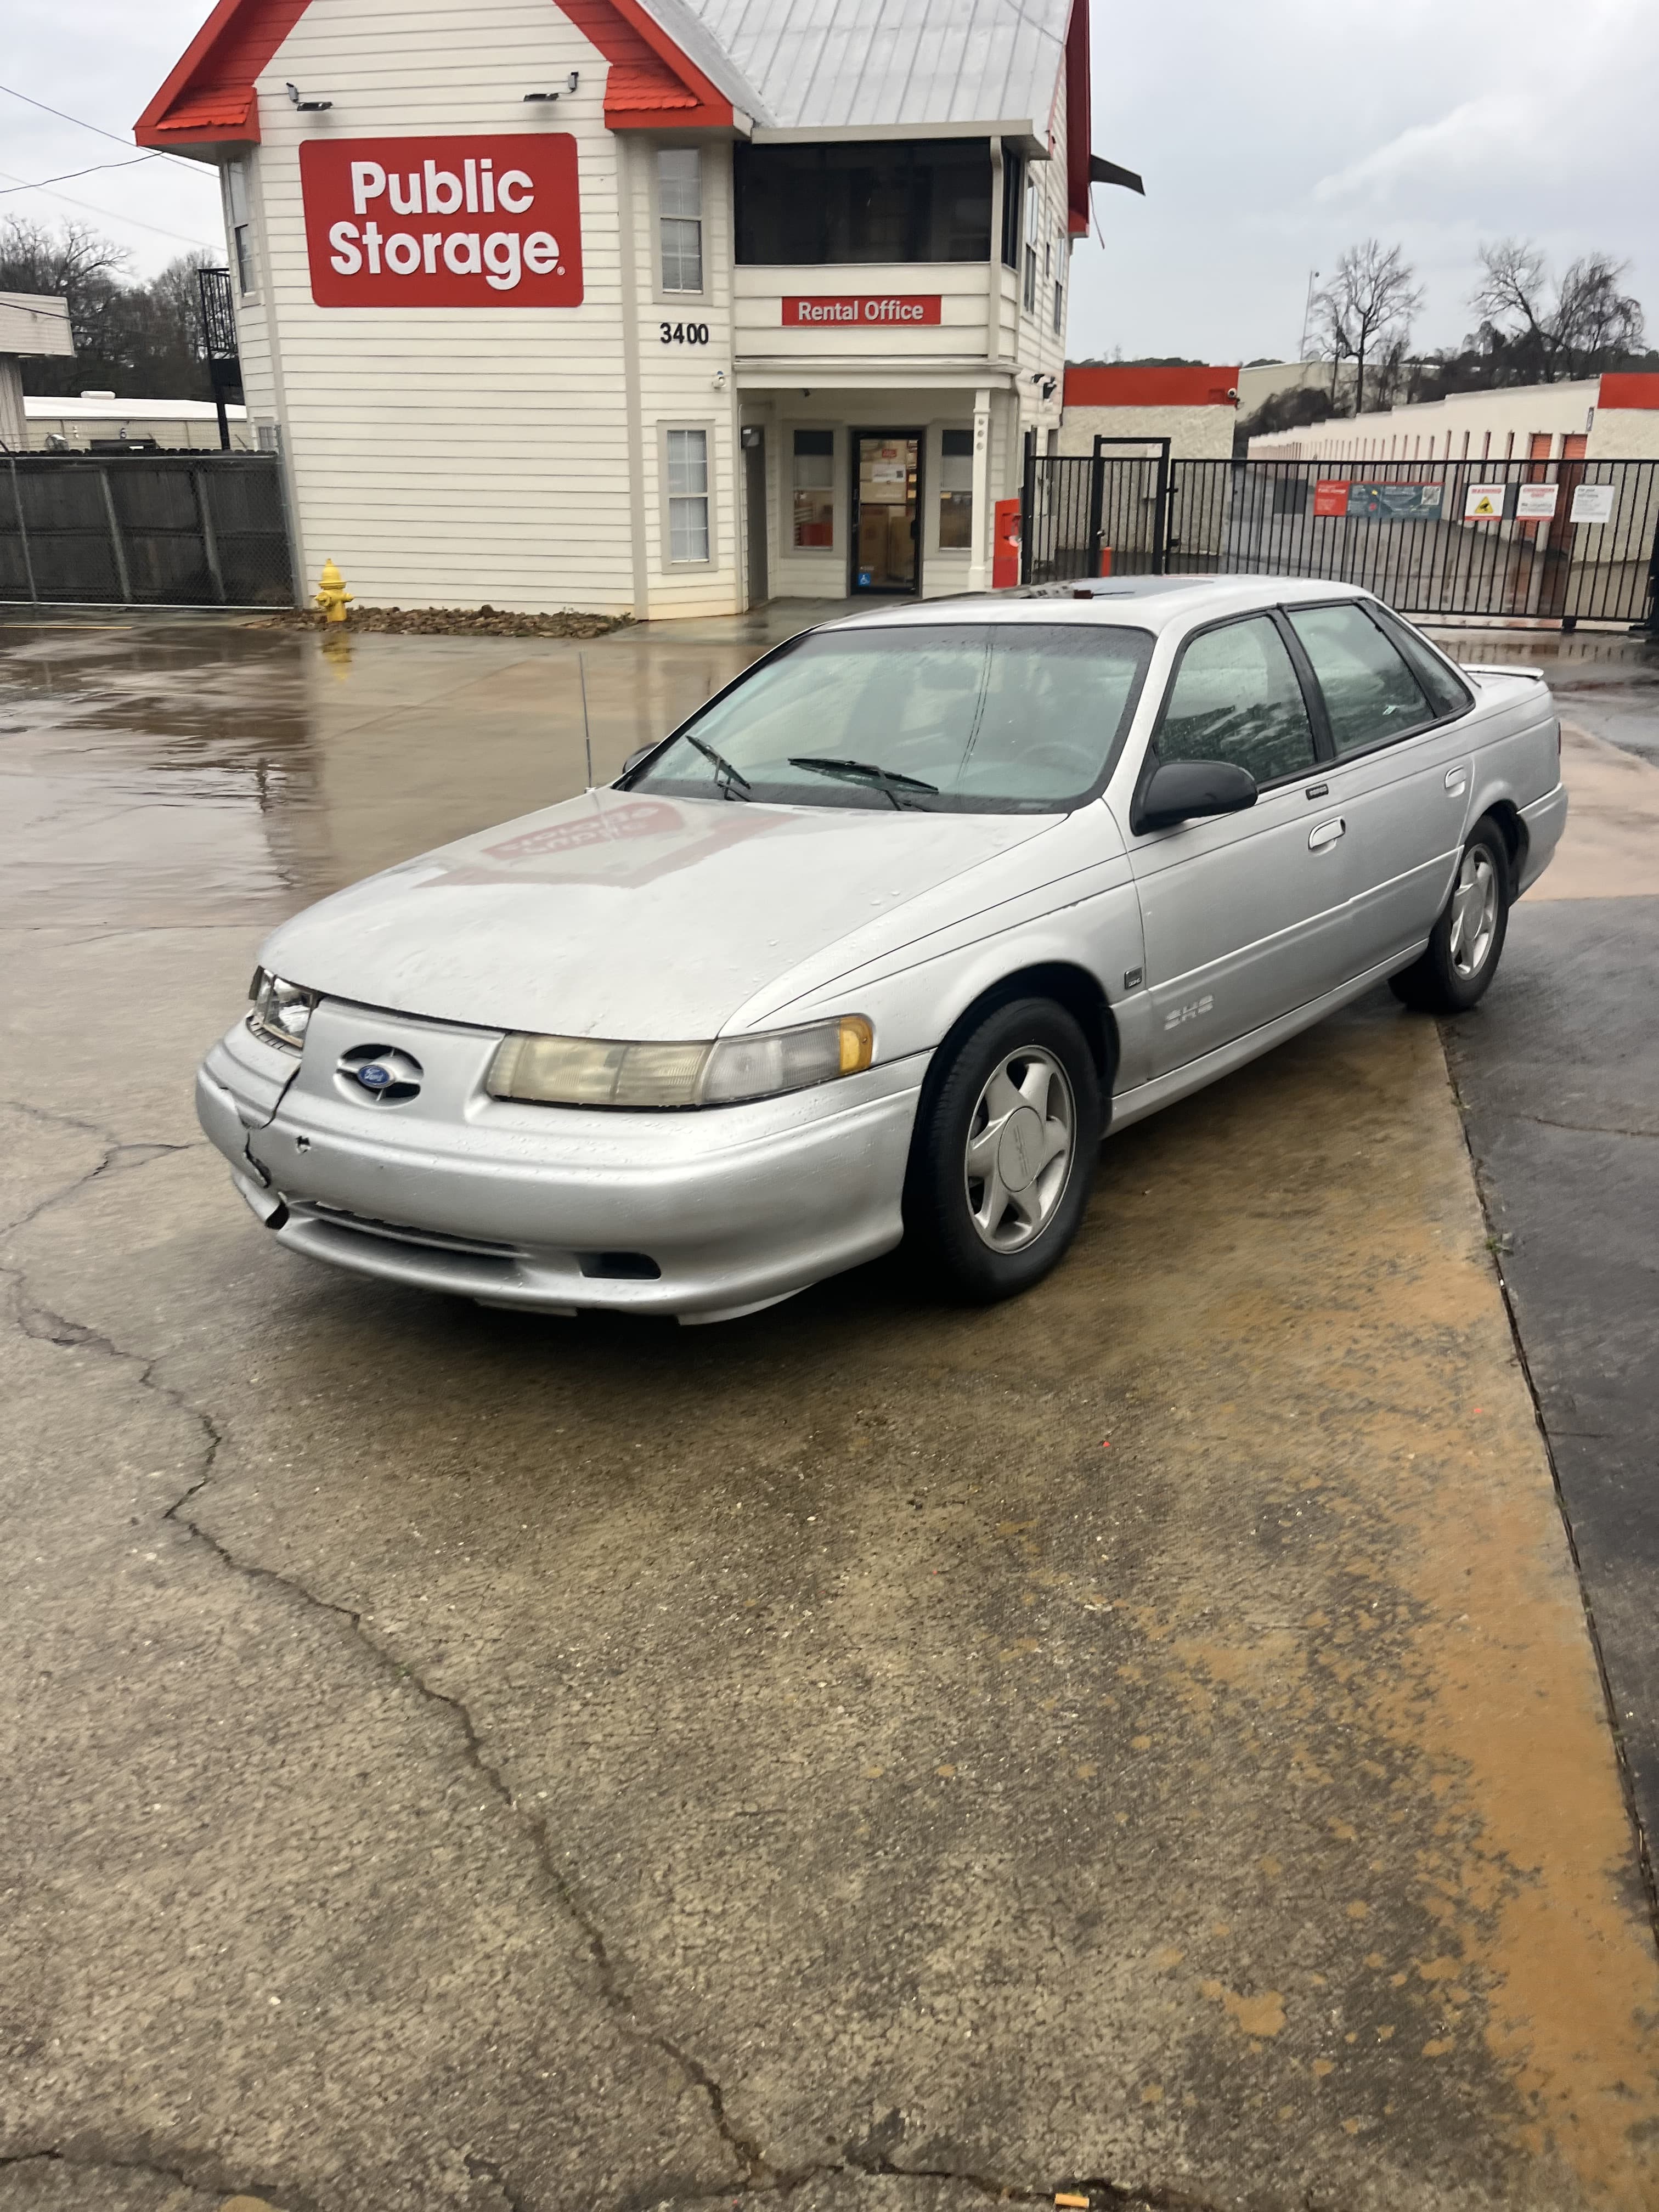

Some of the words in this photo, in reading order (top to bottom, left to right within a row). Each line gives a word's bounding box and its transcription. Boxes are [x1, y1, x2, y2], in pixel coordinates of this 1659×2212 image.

[351, 159, 535, 215] Public
[329, 221, 560, 290] Storage
[798, 301, 859, 321] Rental
[864, 299, 924, 320] Office
[659, 323, 709, 345] 3400
